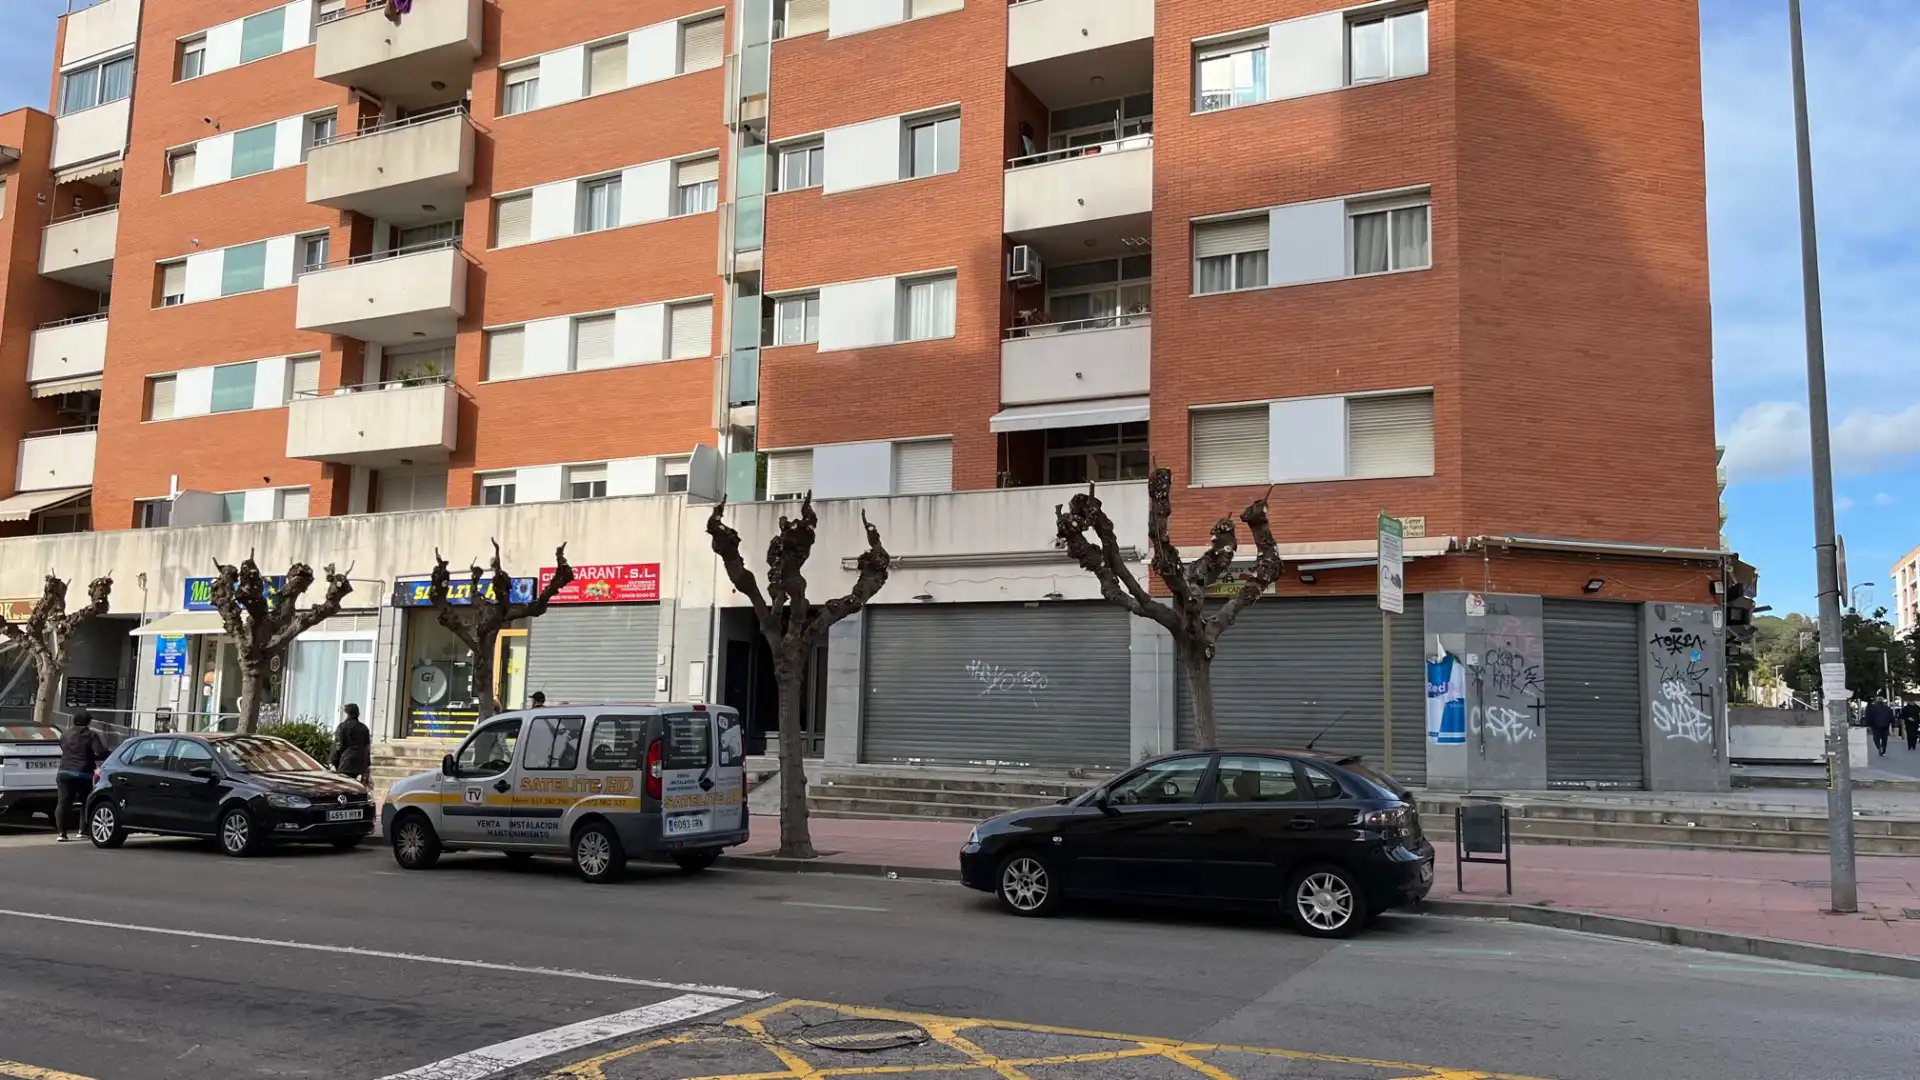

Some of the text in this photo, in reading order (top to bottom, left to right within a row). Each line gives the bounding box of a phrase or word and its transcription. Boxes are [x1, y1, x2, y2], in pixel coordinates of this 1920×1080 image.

[521, 775, 634, 794] SATELITE HD
[467, 790, 481, 801] TV
[476, 819, 559, 830] VENTA INSTALACION
